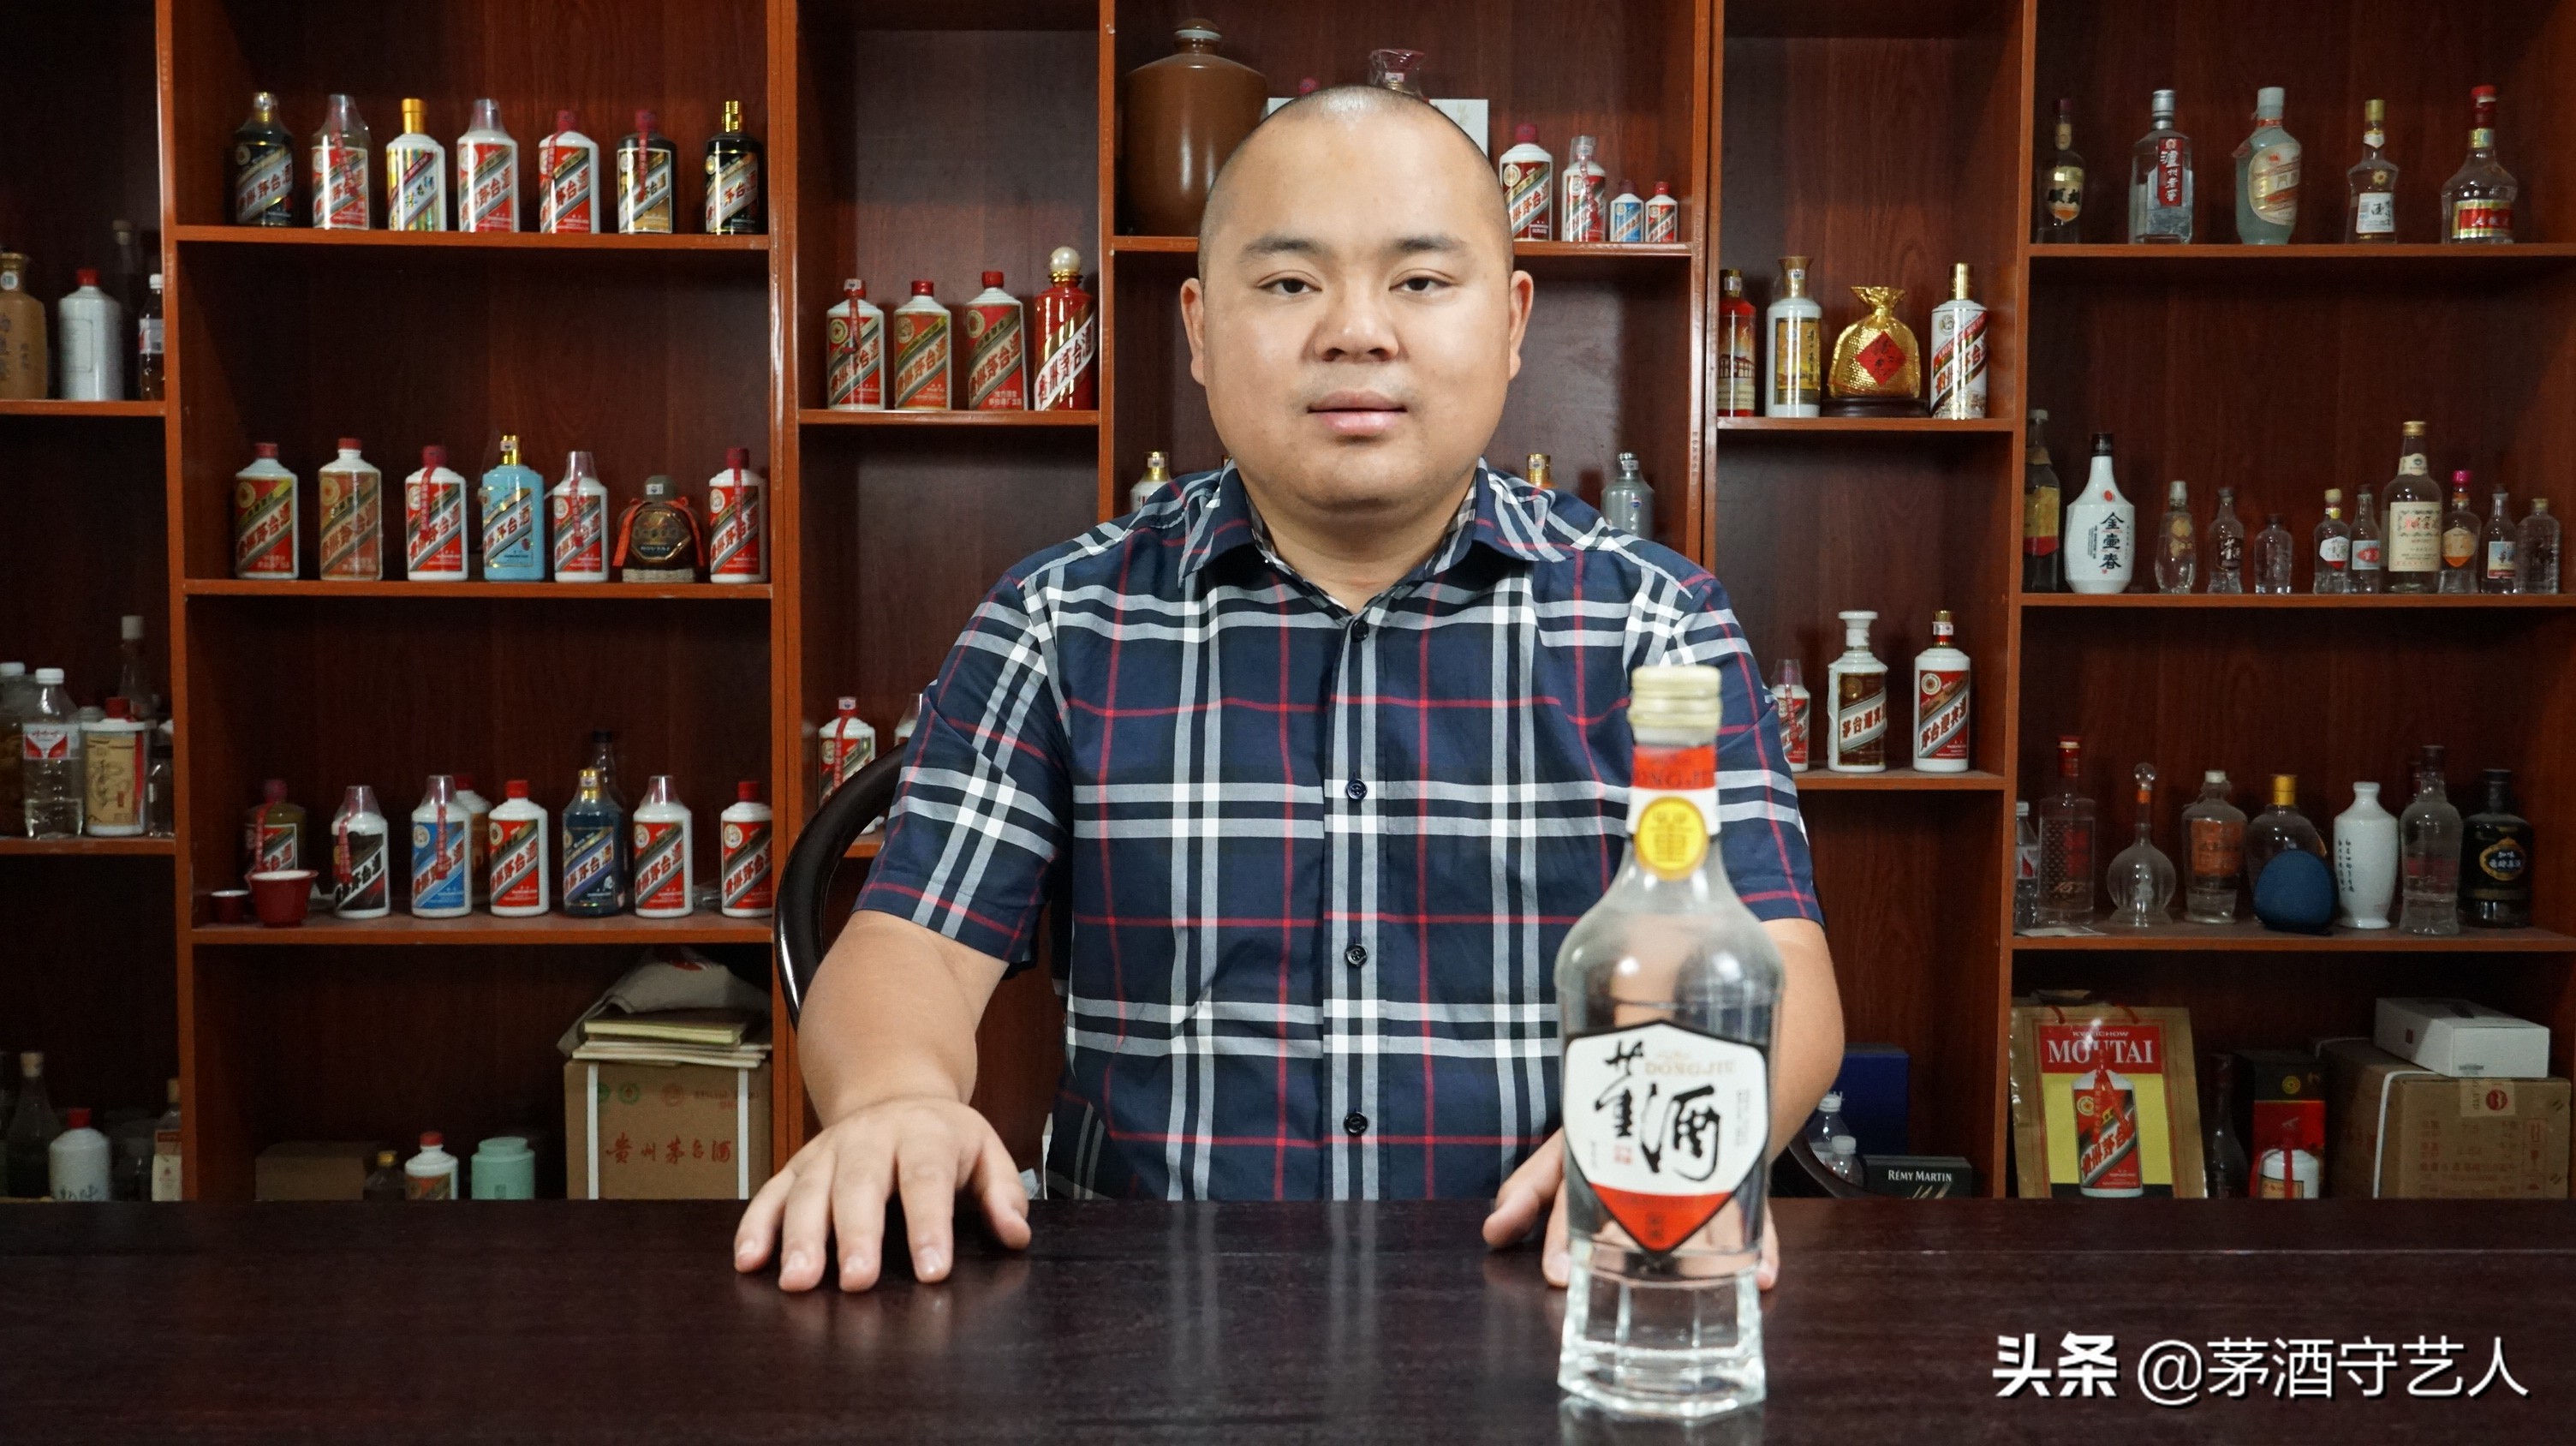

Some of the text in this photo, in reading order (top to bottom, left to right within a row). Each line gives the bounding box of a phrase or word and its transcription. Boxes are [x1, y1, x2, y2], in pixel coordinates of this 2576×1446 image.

[540, 165, 589, 221] 贵茅台酒
[707, 170, 757, 221] 贵茅台酒
[1887, 1168, 1953, 1183] RÉMY MARTIN
